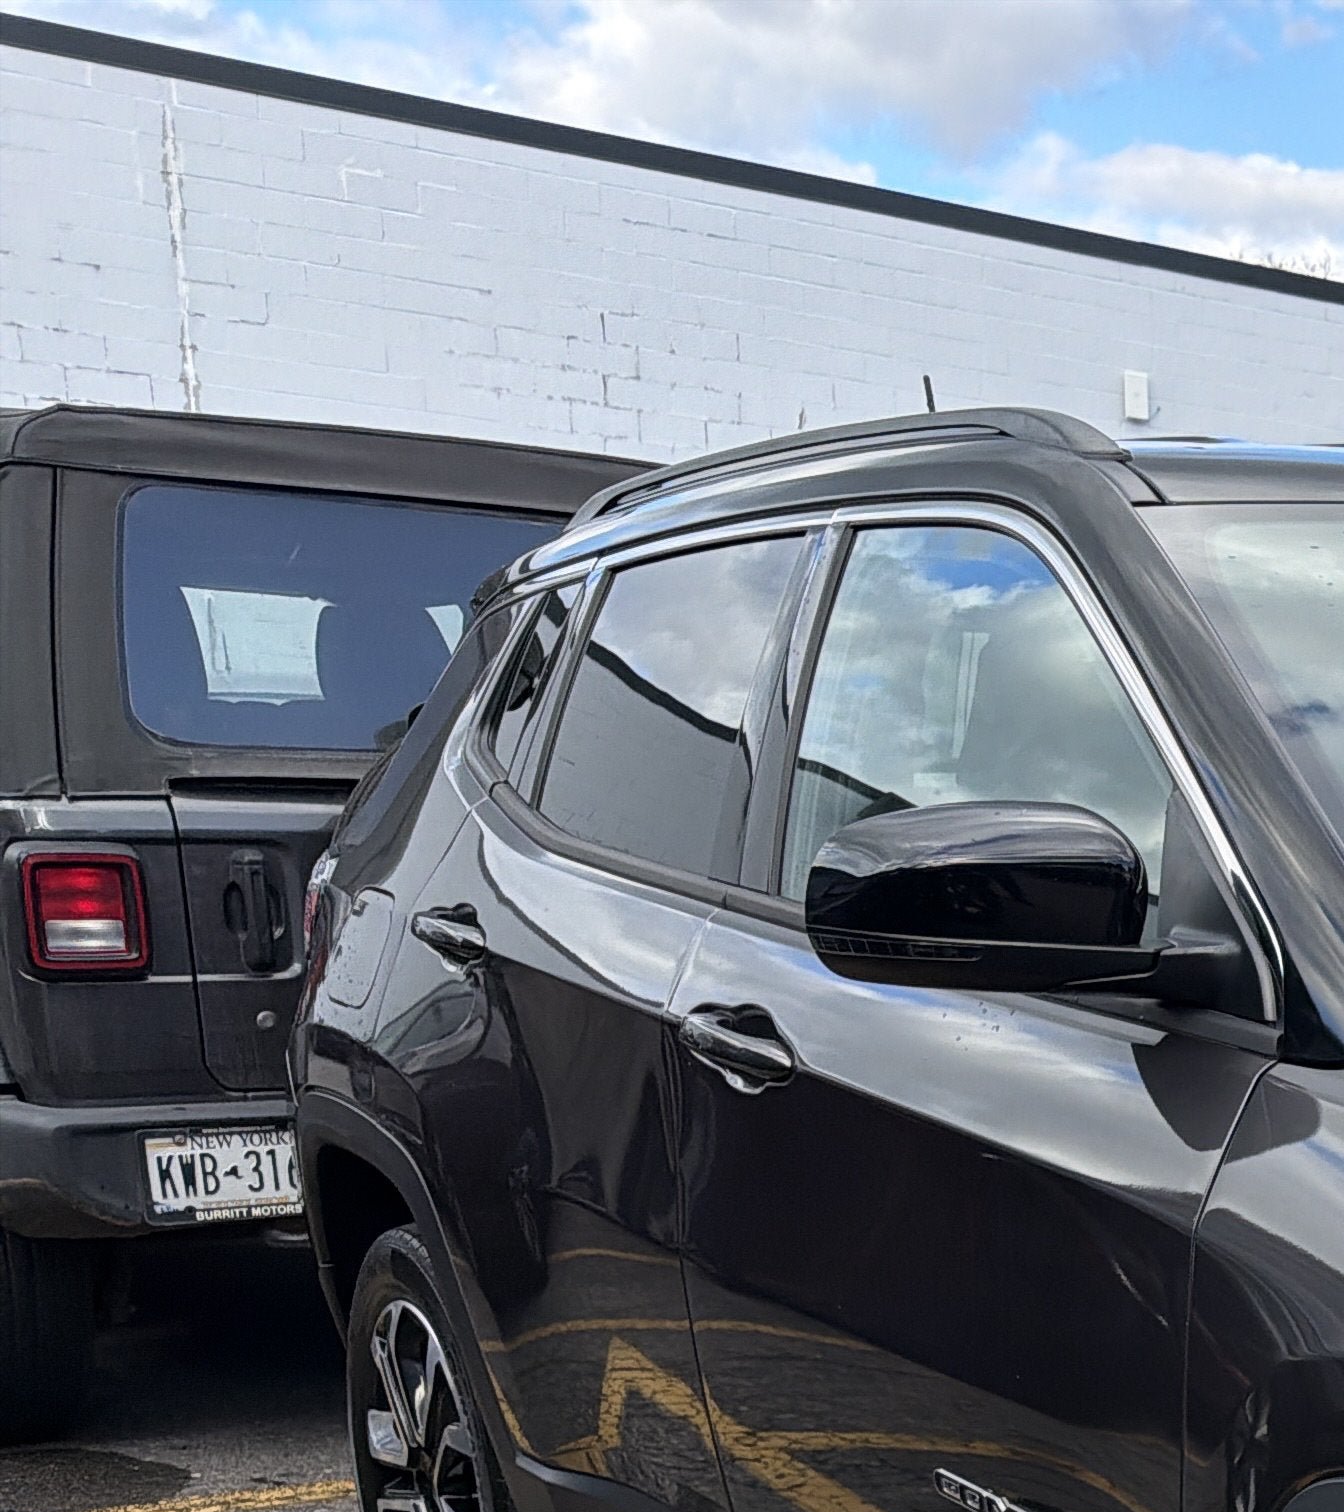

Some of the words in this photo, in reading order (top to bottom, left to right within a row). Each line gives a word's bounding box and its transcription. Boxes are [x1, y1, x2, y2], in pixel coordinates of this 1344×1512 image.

[189, 1134, 233, 1151] NEW
[240, 1130, 289, 1147] YORK
[196, 1208, 248, 1222] BURRITT
[251, 1204, 303, 1217] MOTORS
